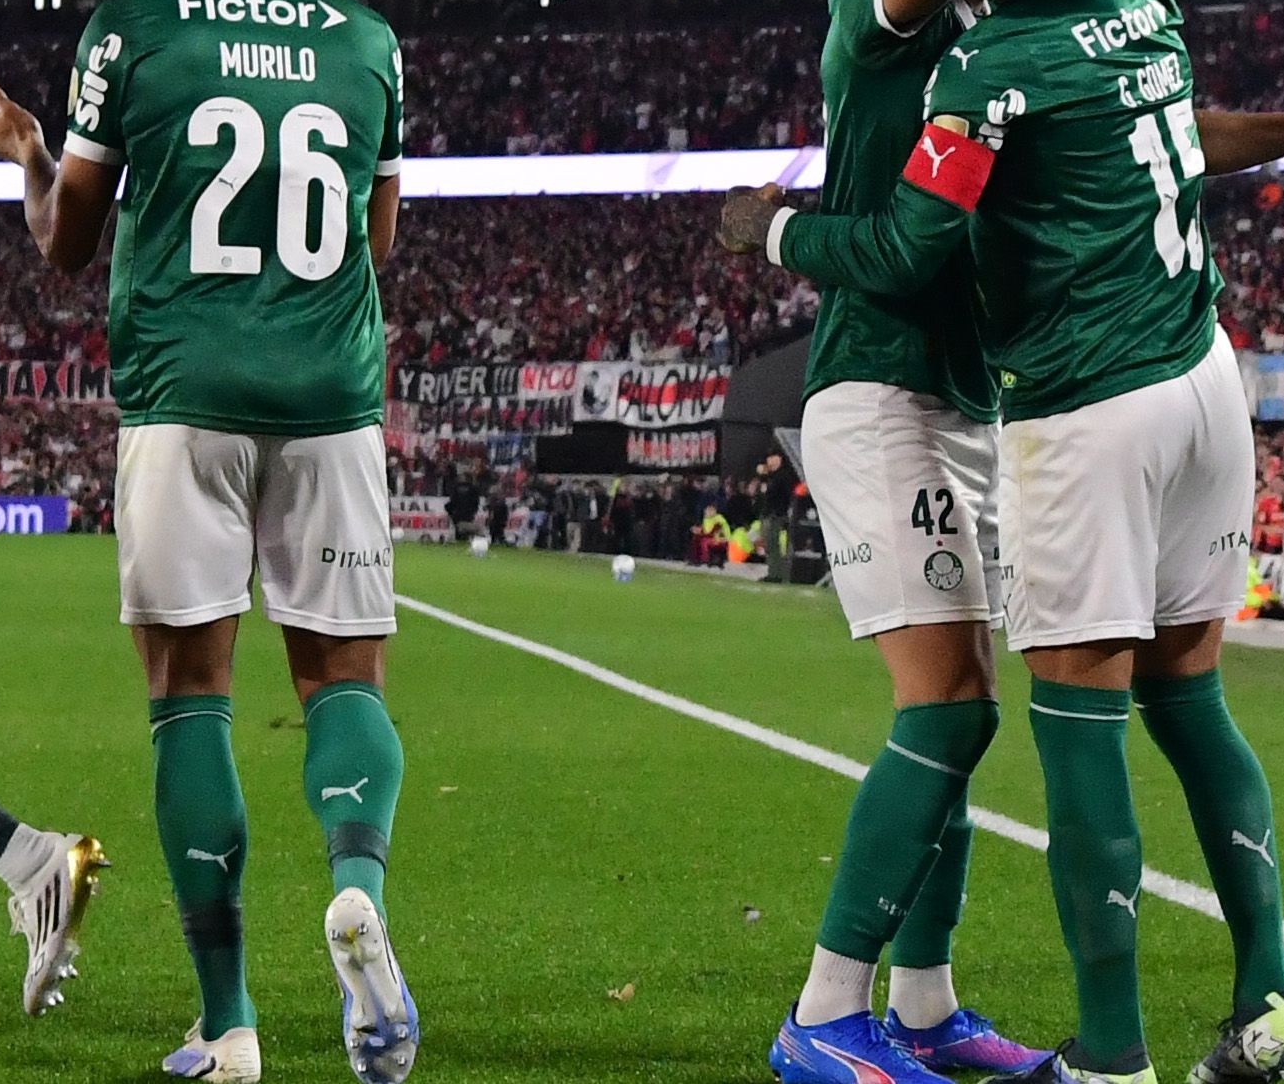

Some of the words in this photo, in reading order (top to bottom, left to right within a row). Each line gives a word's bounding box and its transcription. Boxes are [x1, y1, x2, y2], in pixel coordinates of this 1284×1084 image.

[1070, 4, 1159, 58] Fictor
[219, 41, 316, 82] MURILO
[187, 95, 349, 282] 26
[398, 368, 415, 398] Y
[418, 365, 488, 404] RIVER
[522, 365, 577, 391] NICO
[911, 488, 959, 536] 42
